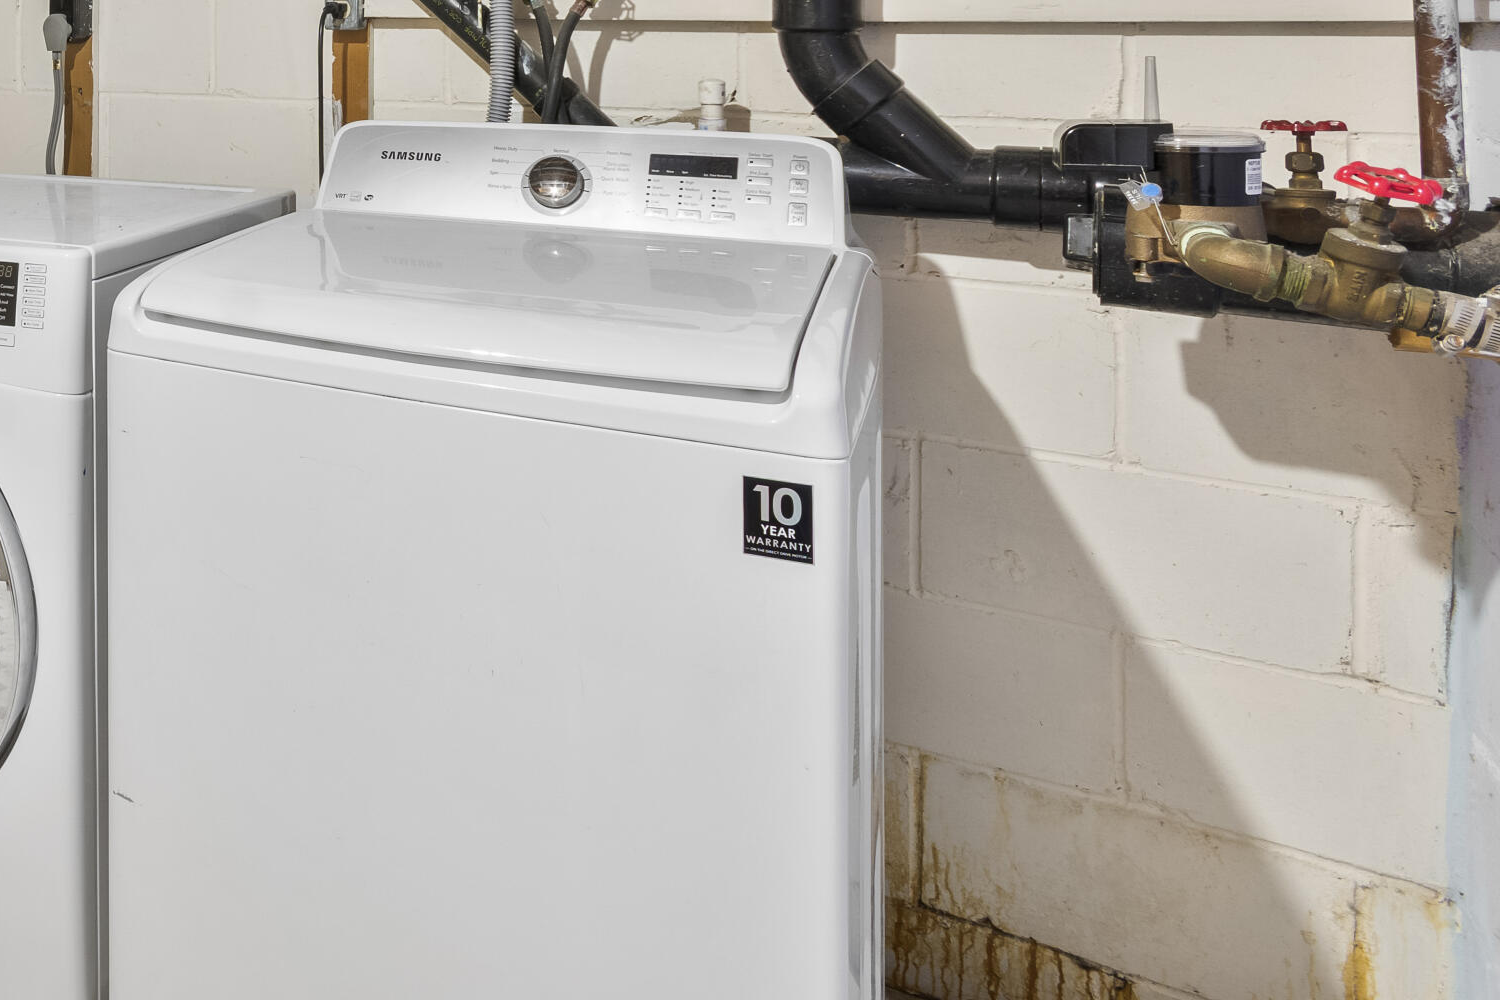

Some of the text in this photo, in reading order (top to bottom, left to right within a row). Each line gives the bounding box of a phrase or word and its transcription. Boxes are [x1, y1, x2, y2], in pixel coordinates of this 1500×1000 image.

[381, 150, 441, 161] SAMSUNG
[753, 484, 802, 526] 10
[760, 524, 796, 540] YEAR
[746, 535, 811, 553] WARRANTY
